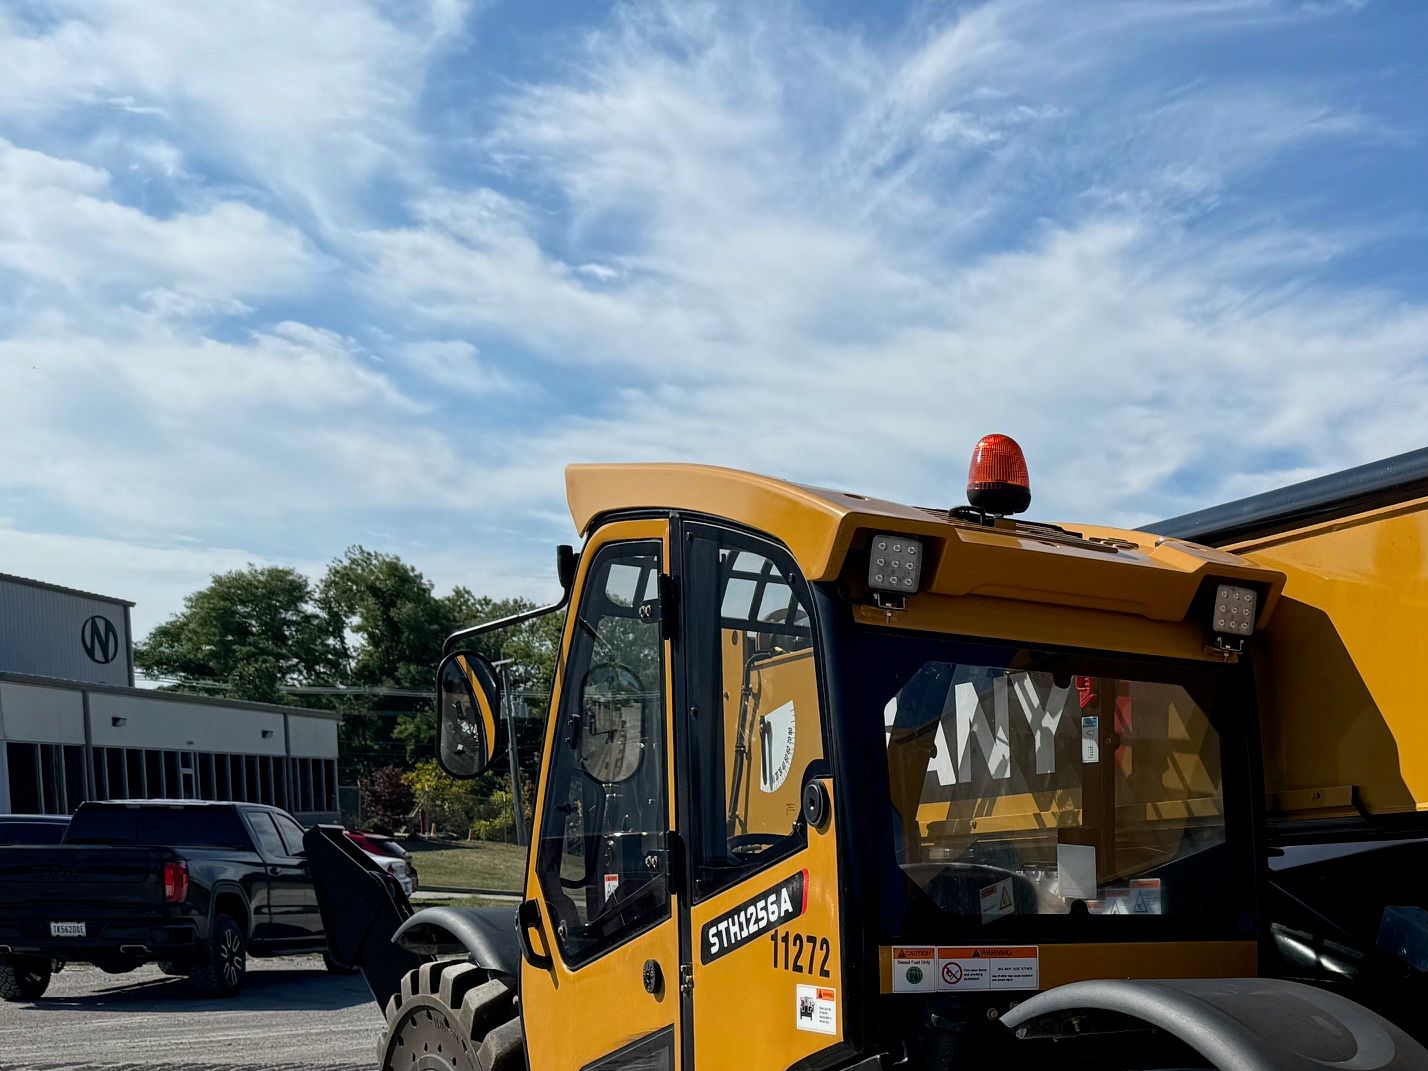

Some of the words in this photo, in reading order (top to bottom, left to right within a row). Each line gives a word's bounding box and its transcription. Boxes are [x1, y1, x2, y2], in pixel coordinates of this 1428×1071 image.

[708, 887, 793, 955] STH1256A
[770, 929, 831, 979] 11272
[980, 949, 1012, 957] WARNING
